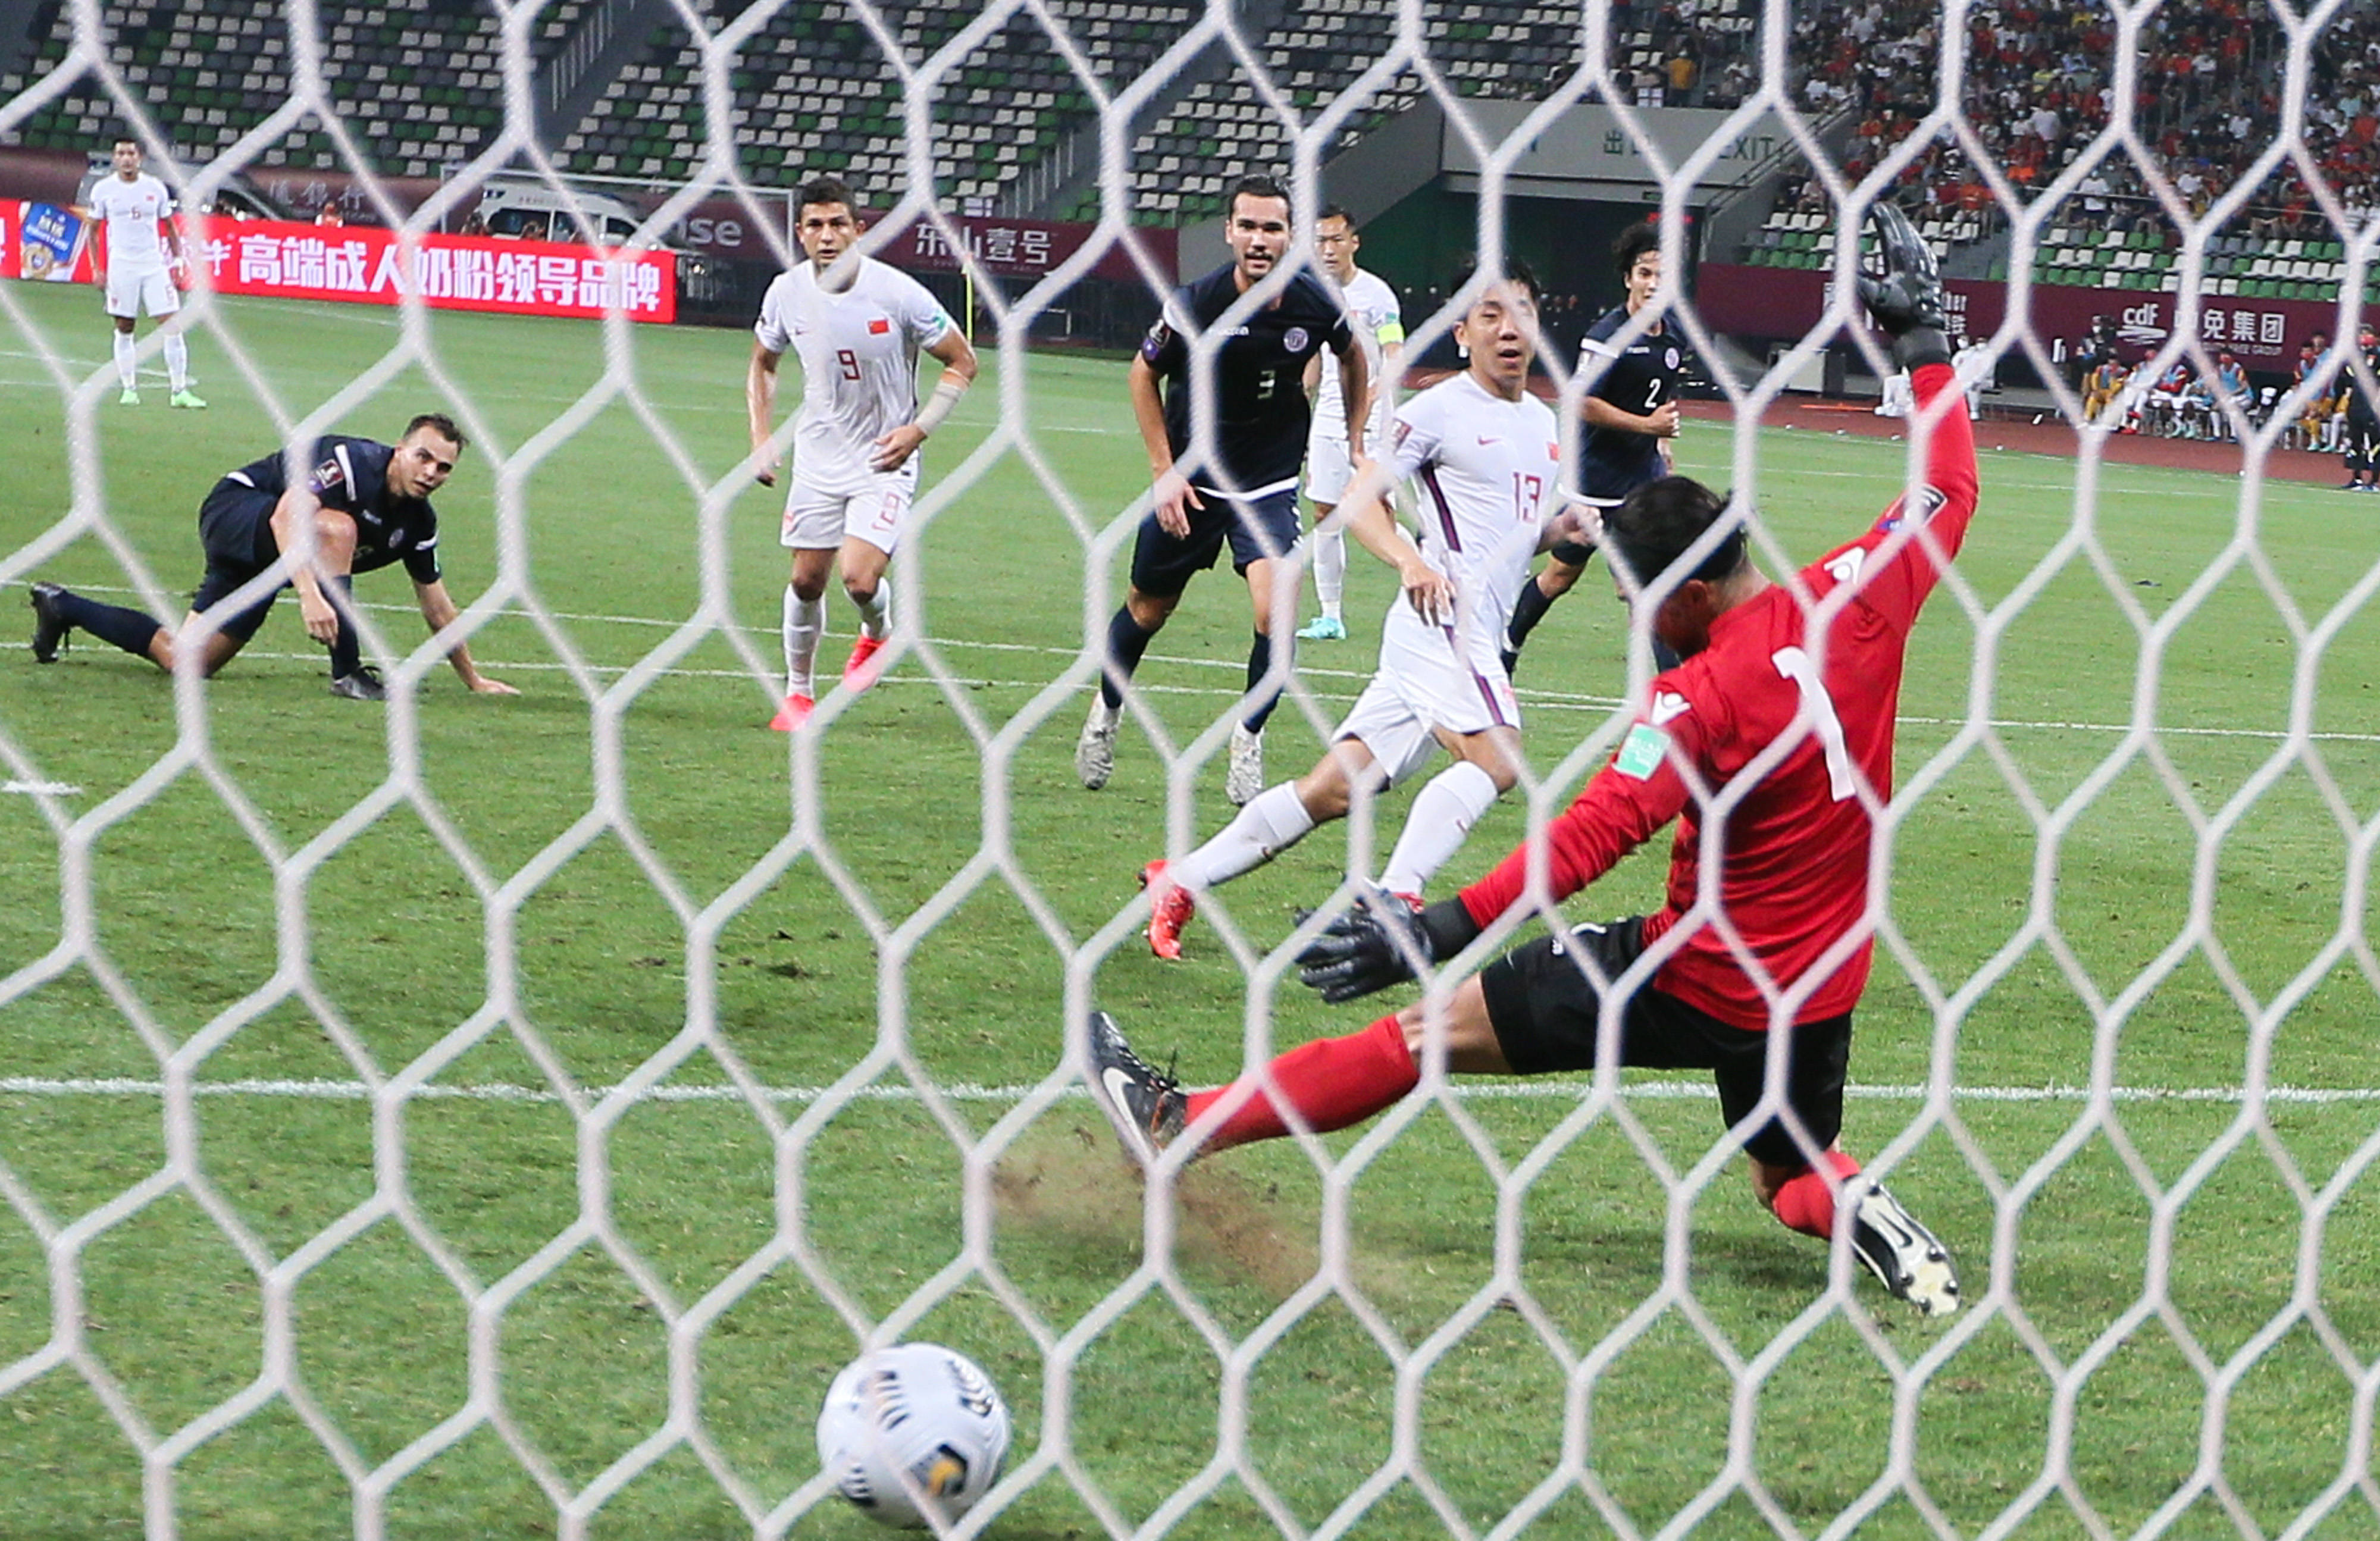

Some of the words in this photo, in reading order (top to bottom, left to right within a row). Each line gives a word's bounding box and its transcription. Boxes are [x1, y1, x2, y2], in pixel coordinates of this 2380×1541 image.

[239, 234, 660, 311] 高端成人奶粉领导品牌
[2122, 303, 2159, 325] cdf
[837, 350, 861, 380] 9
[1257, 369, 1276, 399] 3
[1644, 378, 1662, 408] 2
[1512, 471, 1542, 525] 13
[1771, 646, 1857, 803] 1
